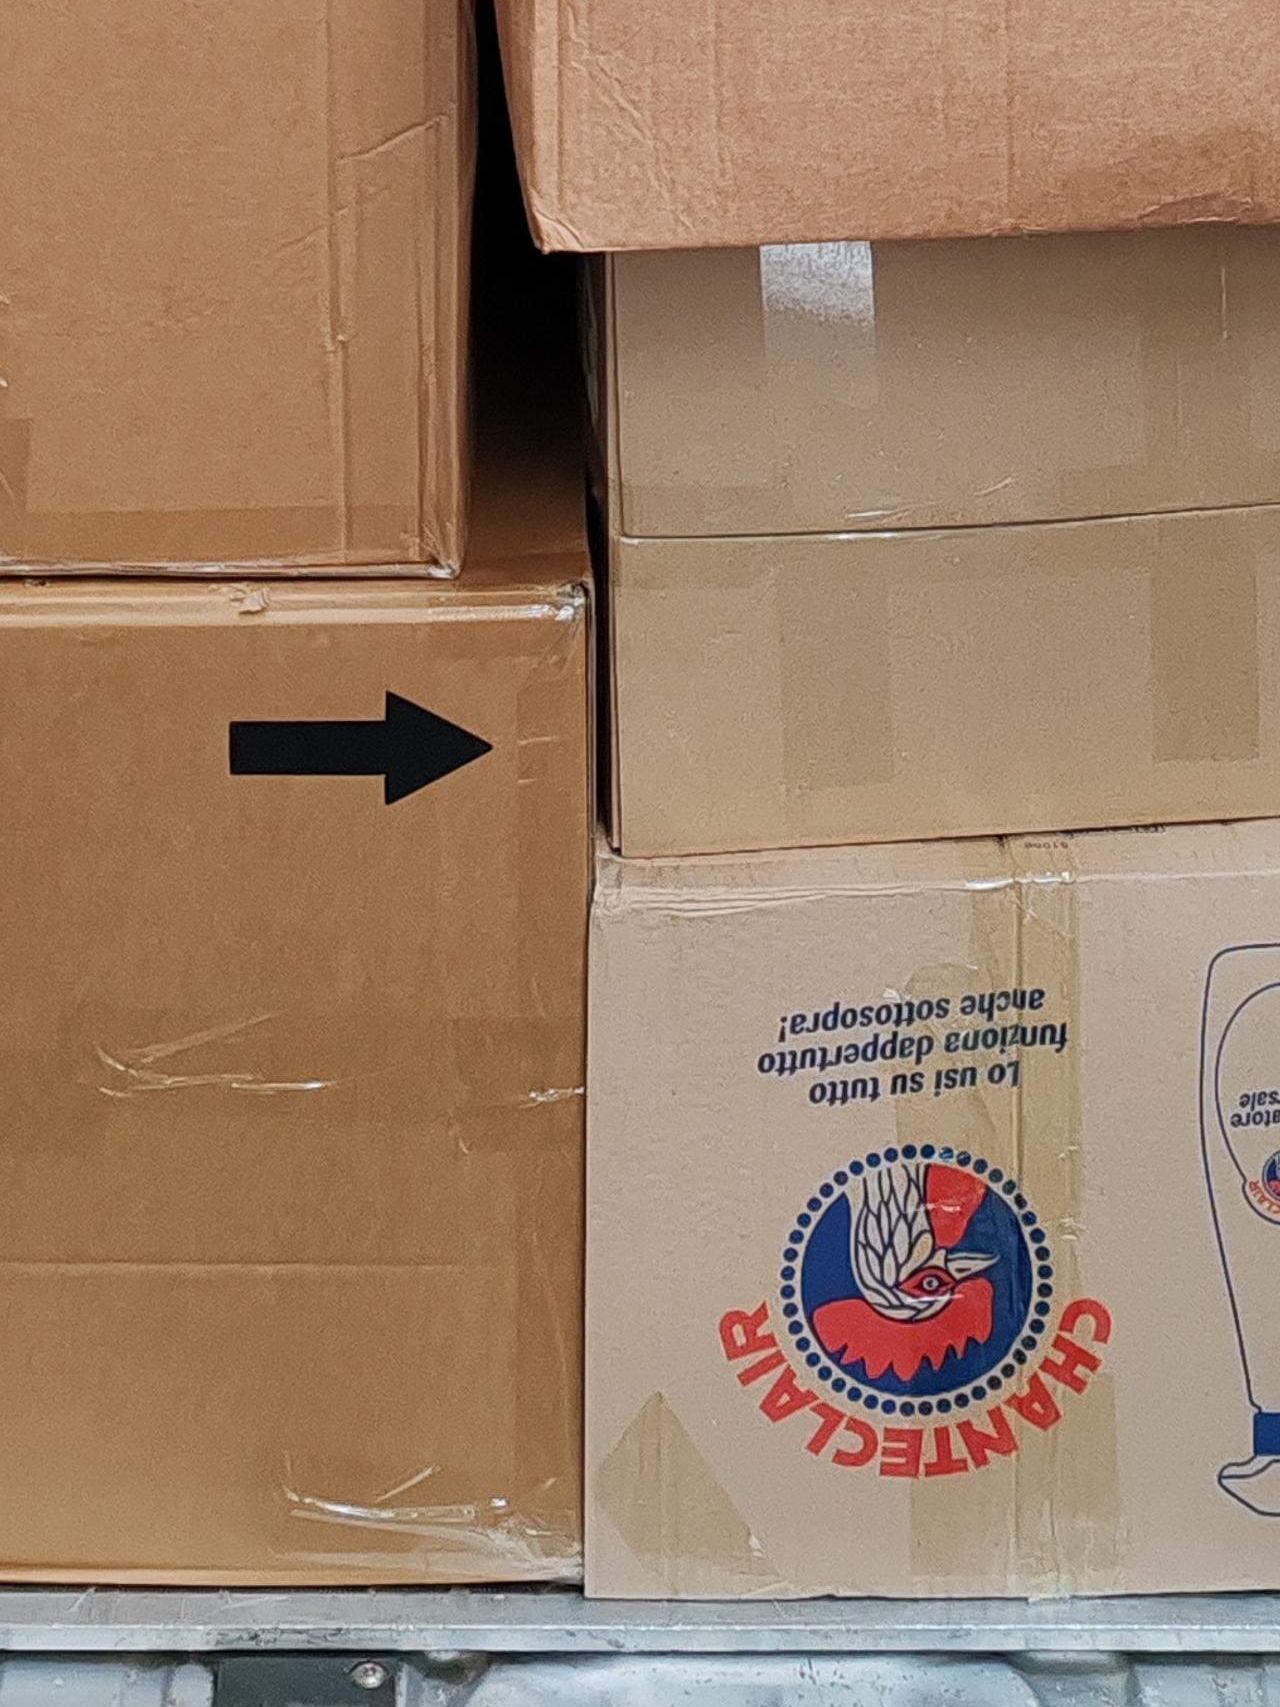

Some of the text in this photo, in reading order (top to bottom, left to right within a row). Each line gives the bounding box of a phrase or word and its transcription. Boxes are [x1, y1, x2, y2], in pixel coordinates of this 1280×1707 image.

[778, 989, 1046, 1043] anche sottosopra!
[756, 1022, 1068, 1079] funziona dappertutto
[809, 1061, 1021, 1107] Lo usi su tutto
[720, 1297, 1113, 1479] CHANTECLAIR
